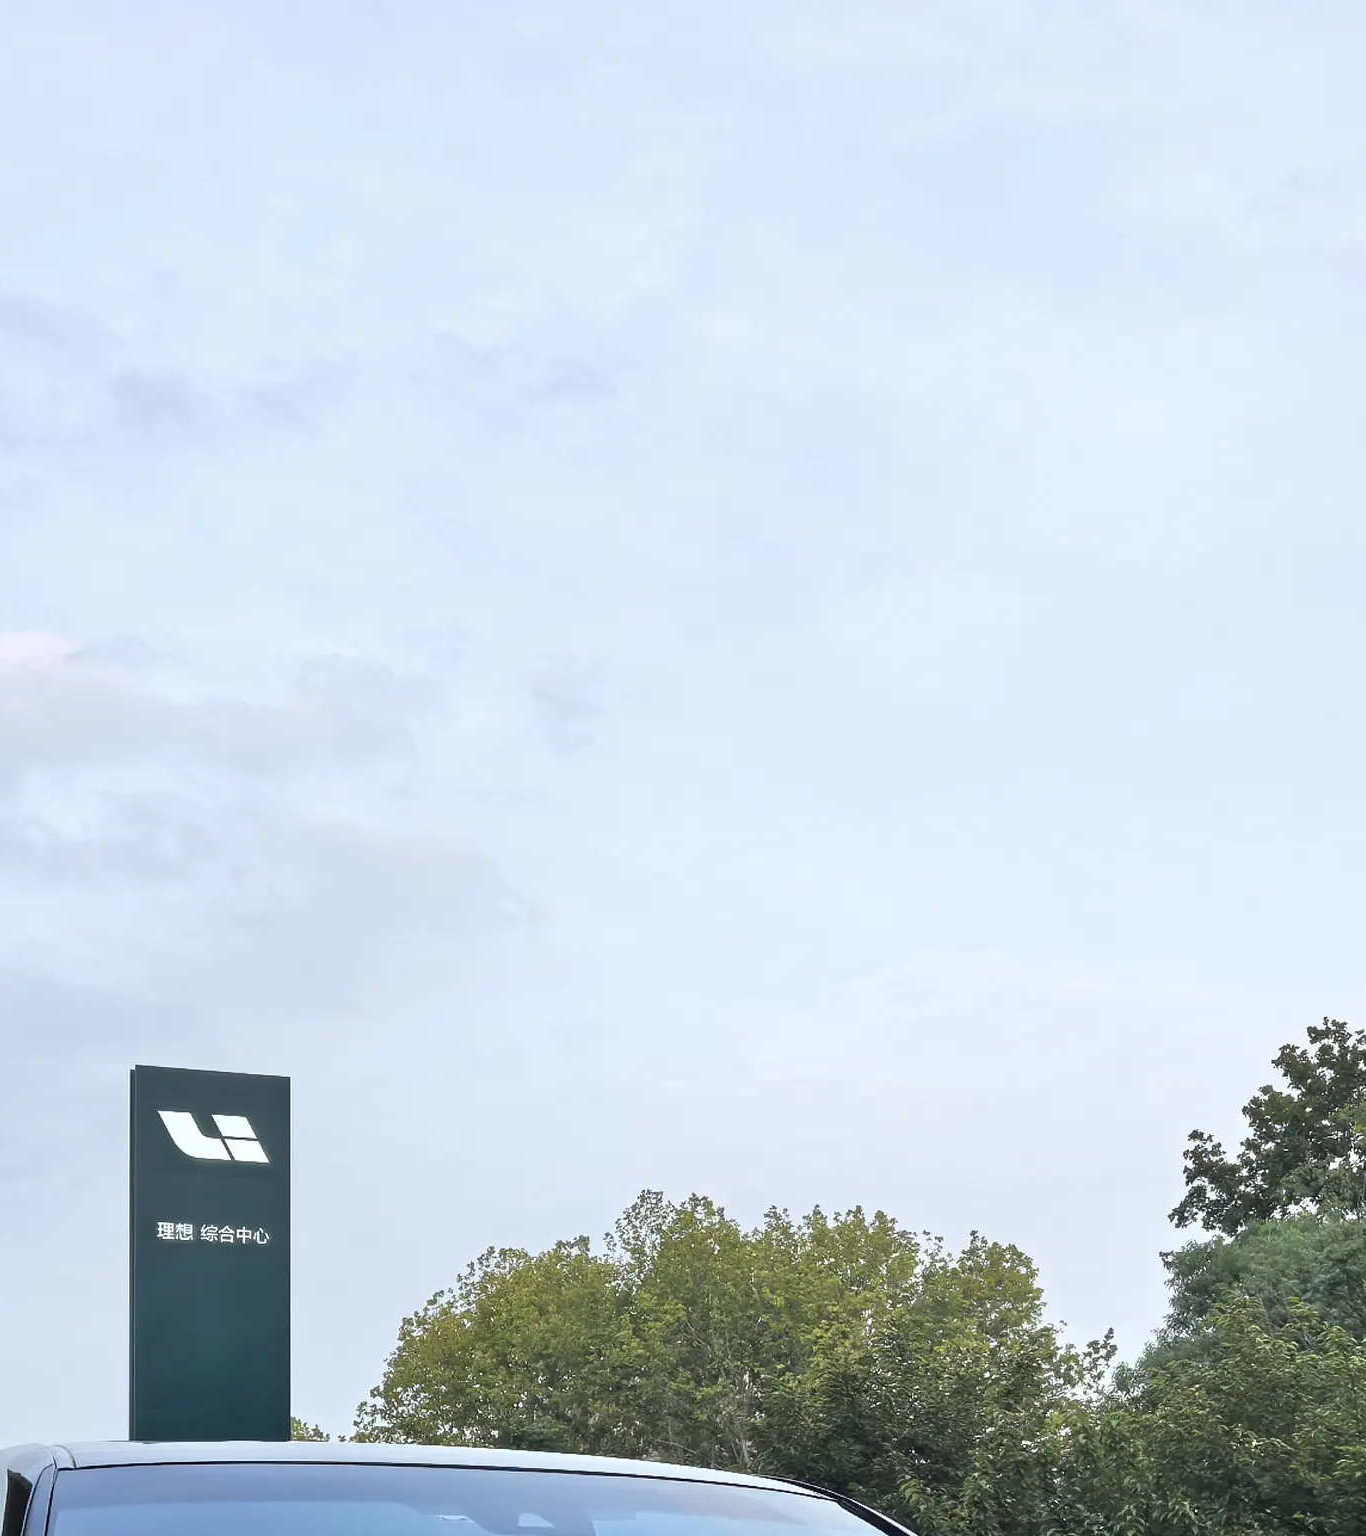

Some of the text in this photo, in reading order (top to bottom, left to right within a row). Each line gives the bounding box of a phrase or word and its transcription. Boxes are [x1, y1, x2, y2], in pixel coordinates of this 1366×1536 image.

[156, 1221, 270, 1245] 理想 综合中心
